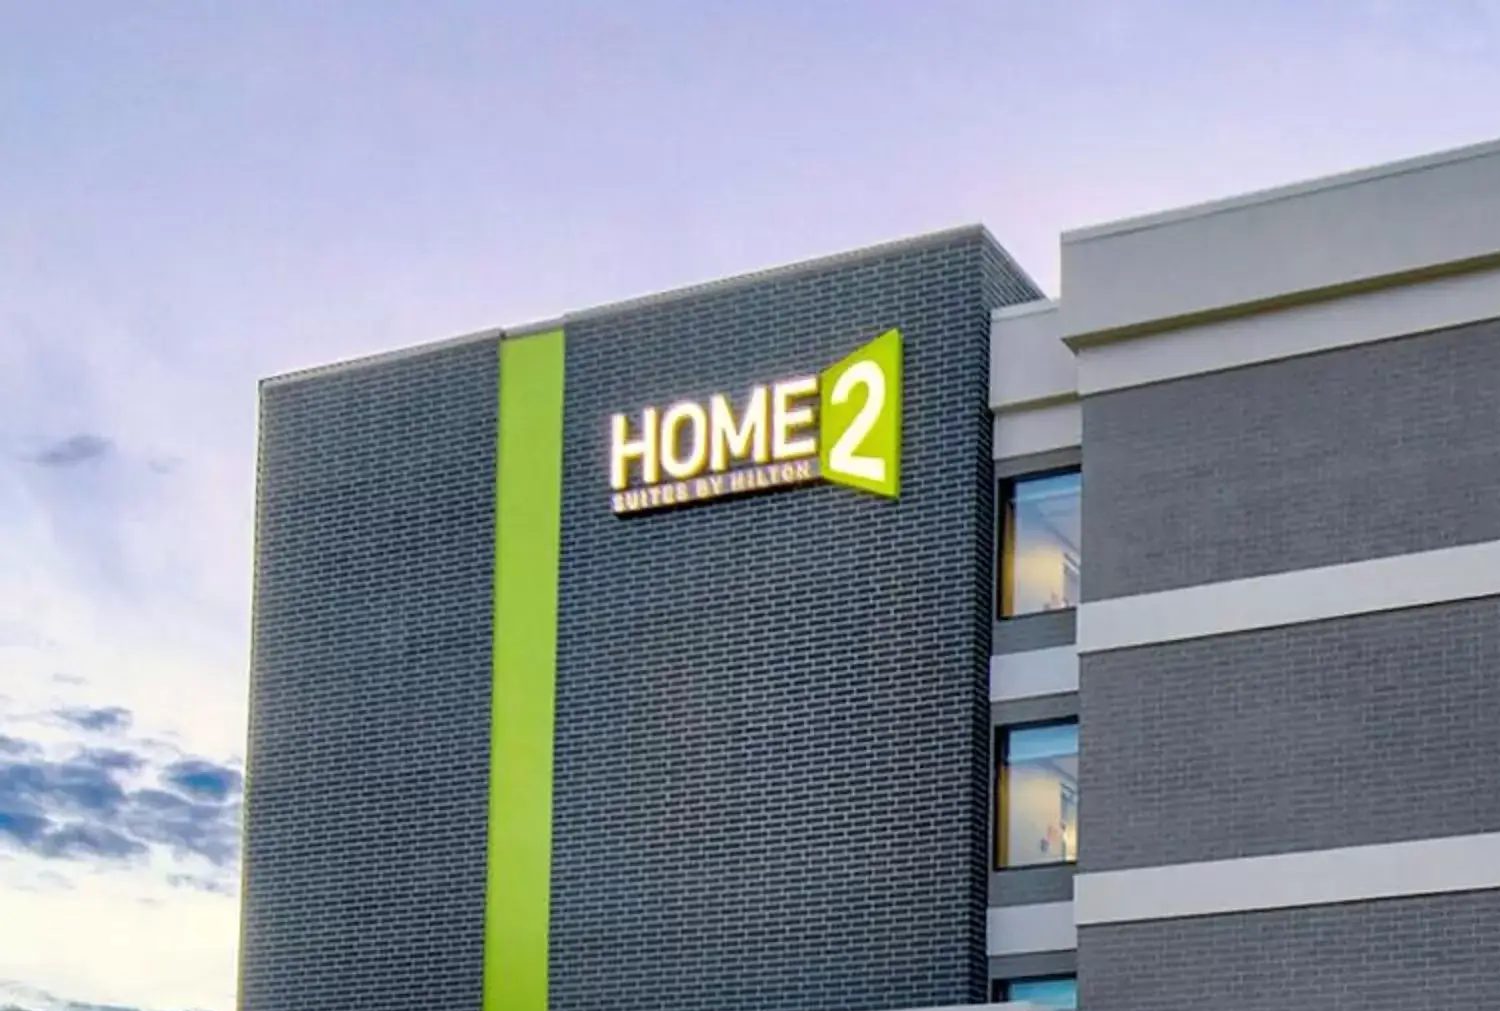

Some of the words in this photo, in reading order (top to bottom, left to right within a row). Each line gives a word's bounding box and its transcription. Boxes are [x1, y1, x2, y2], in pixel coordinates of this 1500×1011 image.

[610, 376, 819, 489] HOME
[829, 360, 885, 481] 2
[612, 480, 690, 512] SUITES
[696, 475, 725, 498] BY
[730, 461, 811, 490] HILTON
